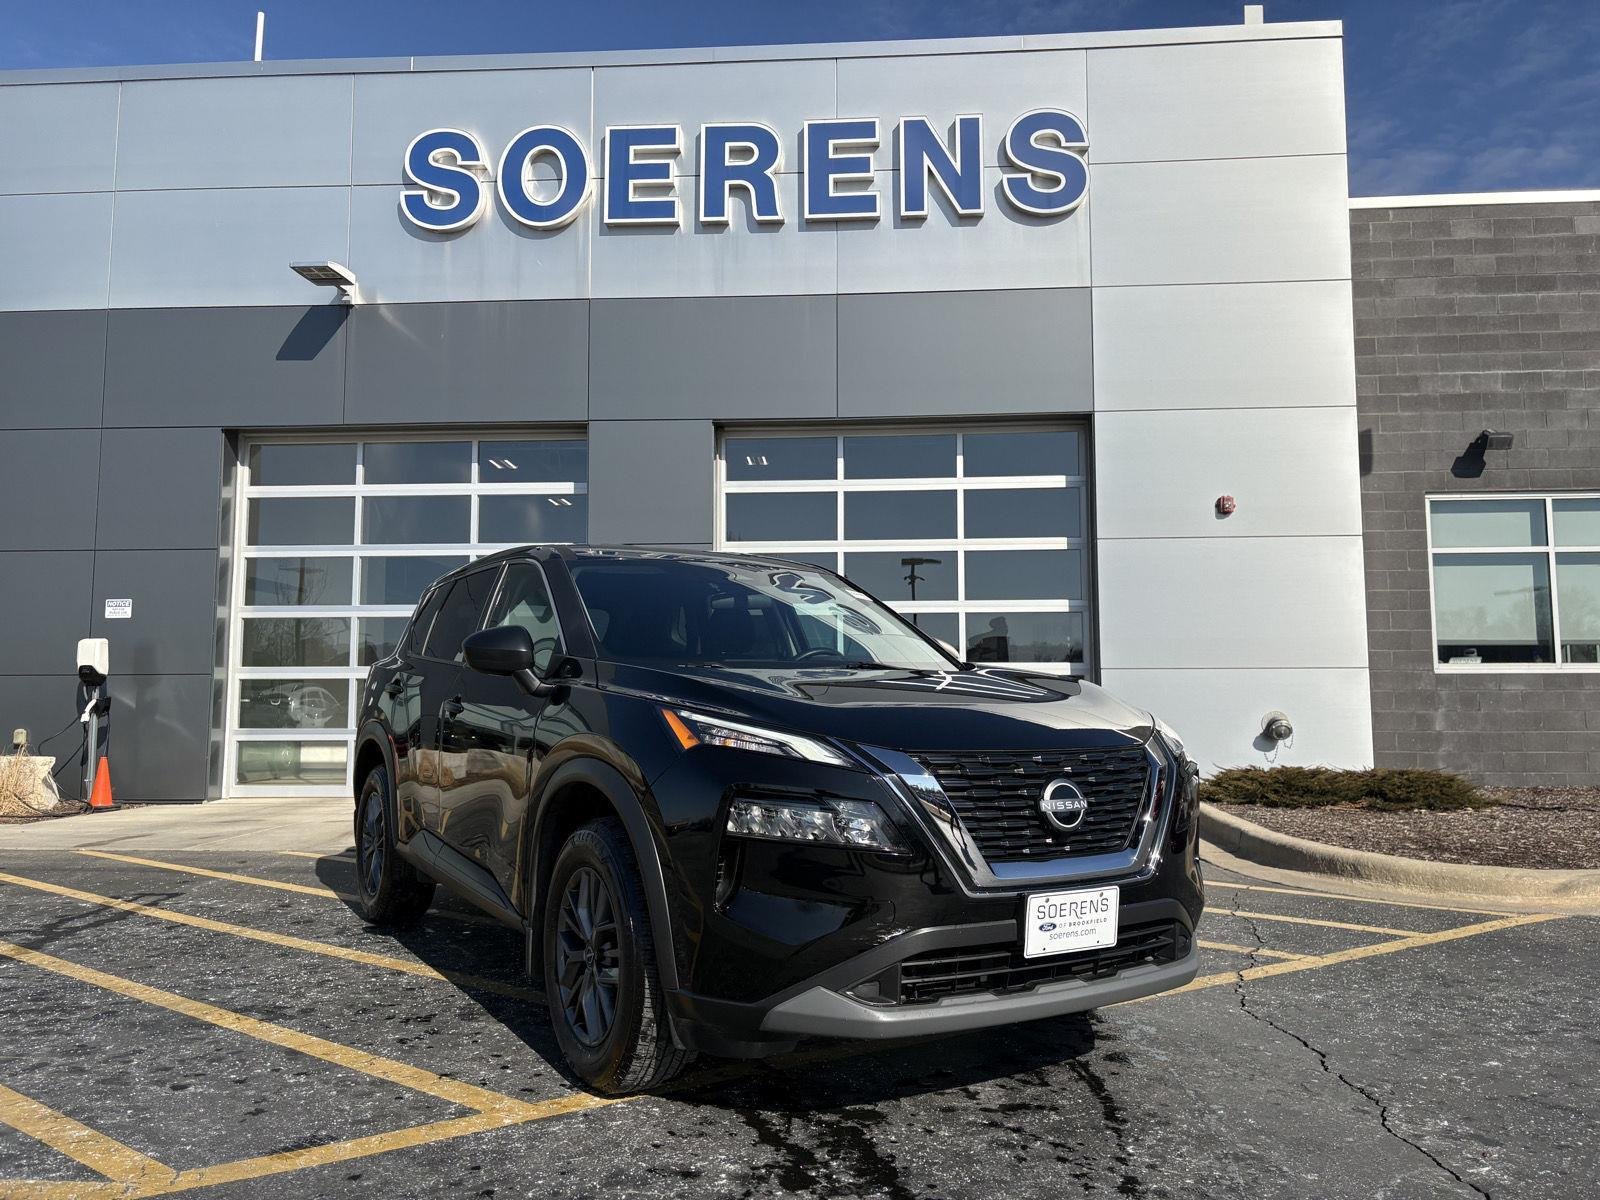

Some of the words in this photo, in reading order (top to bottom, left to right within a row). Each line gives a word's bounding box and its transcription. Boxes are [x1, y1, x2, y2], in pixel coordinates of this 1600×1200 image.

[399, 108, 1090, 230] SOERENS
[1042, 800, 1087, 810] NISSAN
[1037, 898, 1109, 919] SOERENS
[1069, 917, 1107, 928] BROOKFIELD
[1049, 928, 1097, 940] soerens.com
